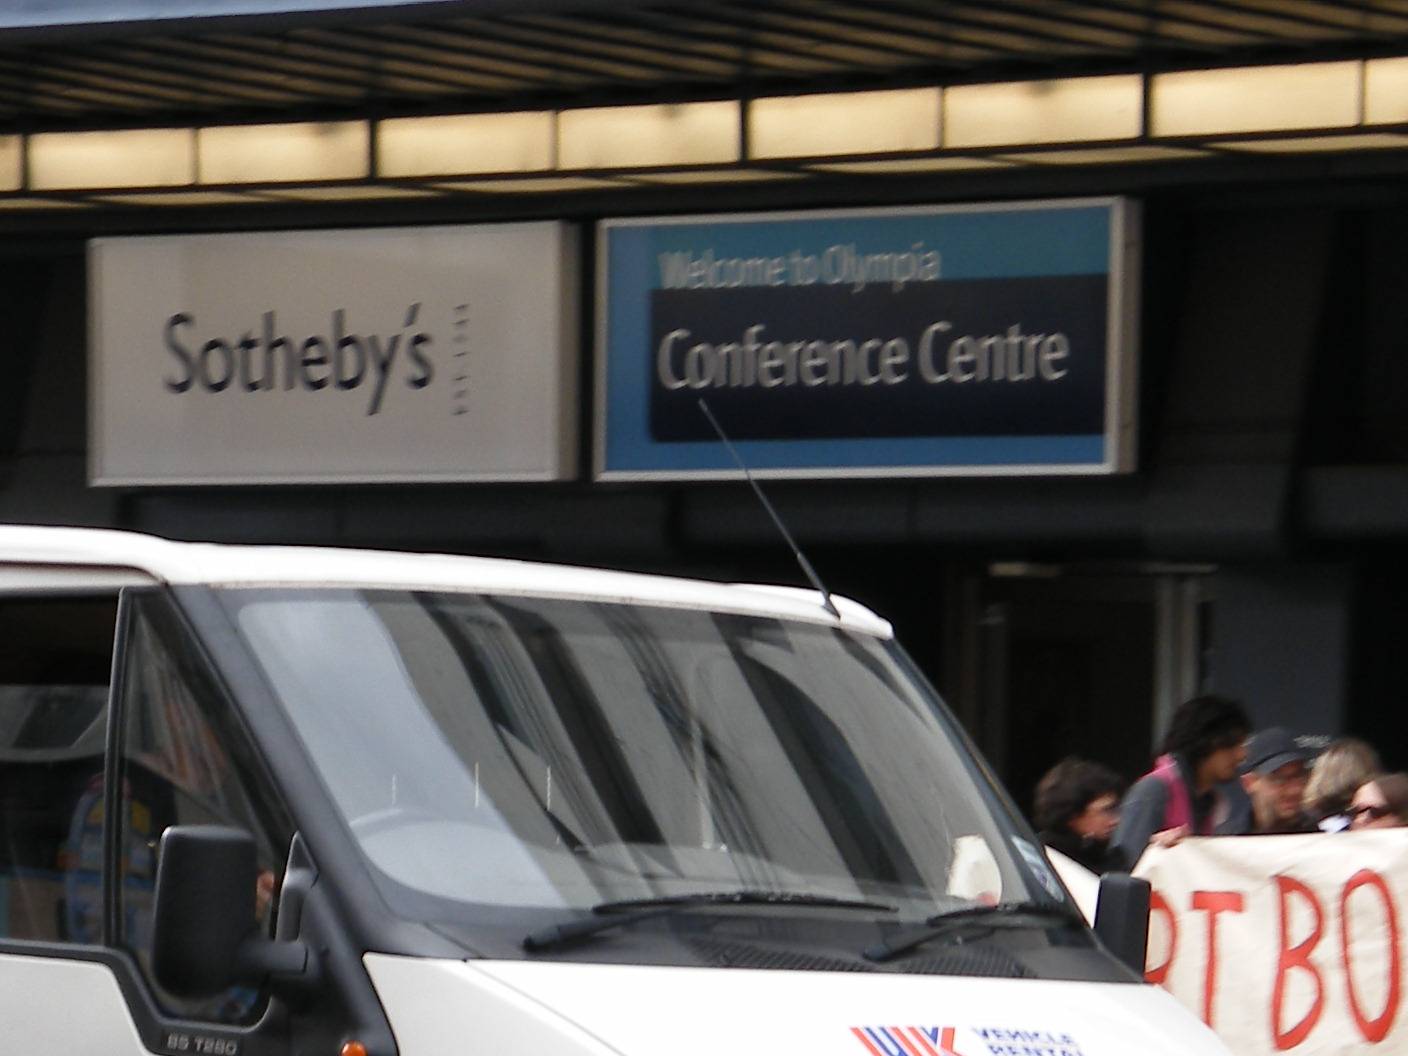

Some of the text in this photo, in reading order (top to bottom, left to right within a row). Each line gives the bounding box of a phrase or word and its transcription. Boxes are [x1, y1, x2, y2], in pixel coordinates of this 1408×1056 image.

[659, 242, 941, 292] Welcome to Olympia
[163, 303, 435, 416] Sotheby's
[657, 321, 1070, 390] Conference Centre
[971, 1026, 1078, 1046] VEHICLE
